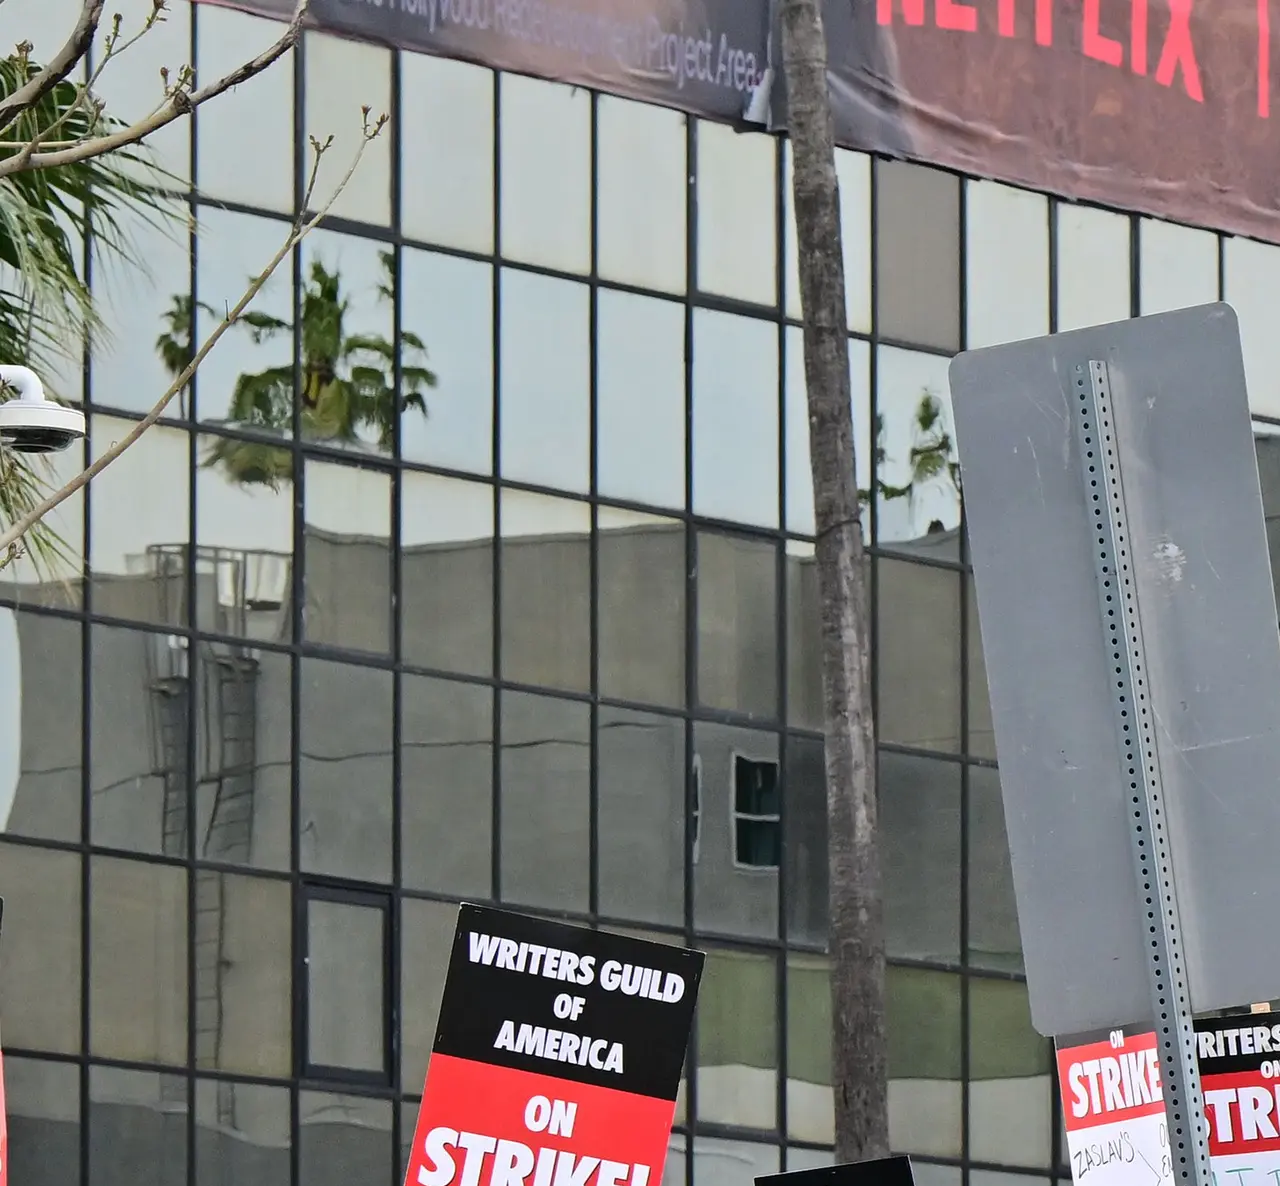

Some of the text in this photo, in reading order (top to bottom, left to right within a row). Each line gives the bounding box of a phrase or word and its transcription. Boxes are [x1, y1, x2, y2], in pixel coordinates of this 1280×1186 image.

[646, 12, 714, 90] Project
[469, 931, 685, 1004] WRITERS GUILD
[553, 994, 586, 1021] OF
[494, 1020, 624, 1074] AMERICA
[1109, 1030, 1125, 1048] ON
[1068, 1048, 1163, 1118] STRIKE
[524, 1095, 577, 1137] ON
